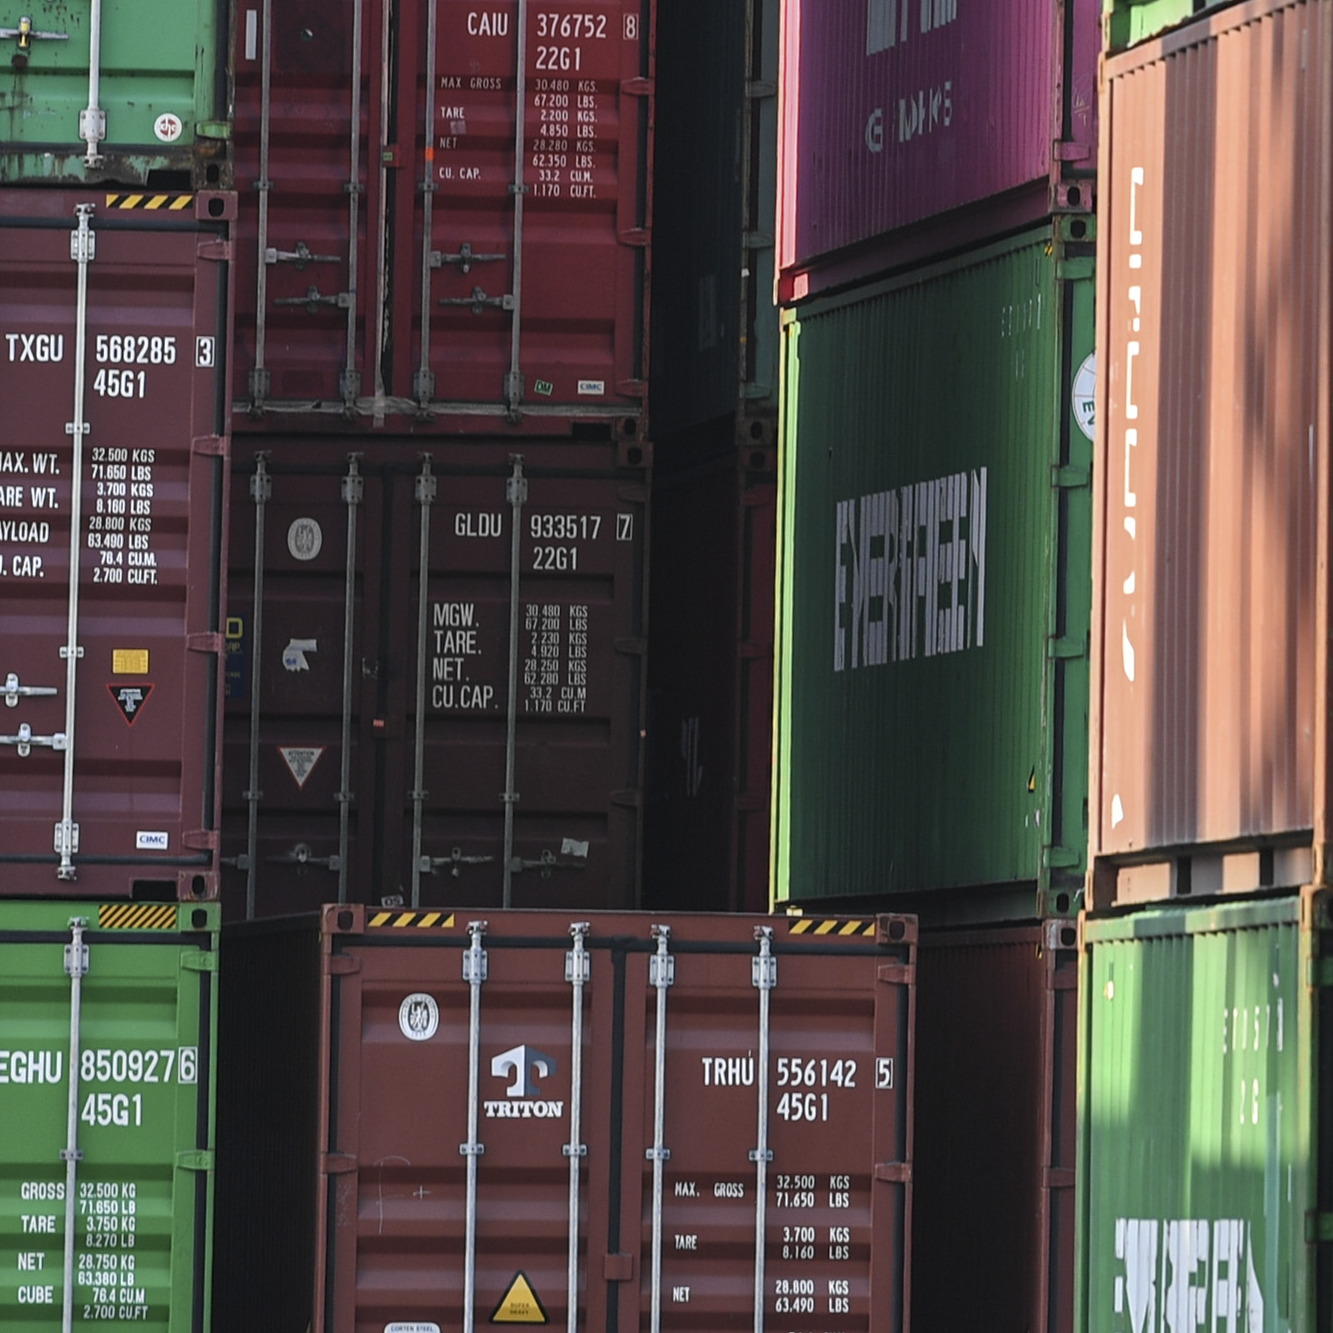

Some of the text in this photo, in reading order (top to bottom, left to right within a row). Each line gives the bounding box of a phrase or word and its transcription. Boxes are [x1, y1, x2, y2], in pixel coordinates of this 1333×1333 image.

[468, 13, 507, 35] CAIU
[538, 14, 606, 38] 376752
[536, 46, 580, 70] 22G1
[441, 77, 501, 89] MAX GROSS
[442, 107, 464, 118] TARE
[440, 137, 456, 148] NET
[6, 334, 63, 361] TXGU
[97, 336, 175, 363] 568285
[94, 369, 144, 398] 45G1
[33, 454, 59, 474] WT.
[31, 487, 58, 508] WT.
[456, 513, 501, 536] GLDU
[531, 515, 601, 539] 933517
[13, 556, 43, 577] CAP.
[533, 547, 576, 570] 22G1
[434, 603, 479, 626] MGW.
[434, 631, 481, 654] TARE.
[433, 658, 469, 681] NET.
[139, 835, 166, 846] CIMC
[81, 1050, 174, 1082] 850927
[702, 1058, 753, 1085] TRHU
[778, 1058, 856, 1087] 556142
[82, 1094, 141, 1126] 45G1
[484, 1101, 563, 1117] TRITON
[777, 1093, 827, 1121] 45G1
[22, 1183, 135, 1199] GROSS 32.500 KG
[675, 1175, 849, 1197] MAX. GROSS 32.500 KGS
[80, 1200, 135, 1214] 71.650 LB
[777, 1192, 848, 1207] 71.650 LBS
[21, 1215, 135, 1232] TARE 3.750 KG
[86, 1233, 134, 1247] 8.270 LB
[675, 1227, 849, 1249] TARE 3.700 KGS
[18, 1253, 134, 1270] NET 28.750 KG
[783, 1245, 848, 1259] 8.160 LBS
[79, 1271, 134, 1286] 63.380 LB
[18, 1286, 53, 1303] CUBE
[93, 1287, 115, 1302] 76.4
[673, 1280, 848, 1301] NET 28.800 KGS
[84, 1305, 115, 1318] 2.700
[776, 1297, 848, 1312] 63.490 LBS
